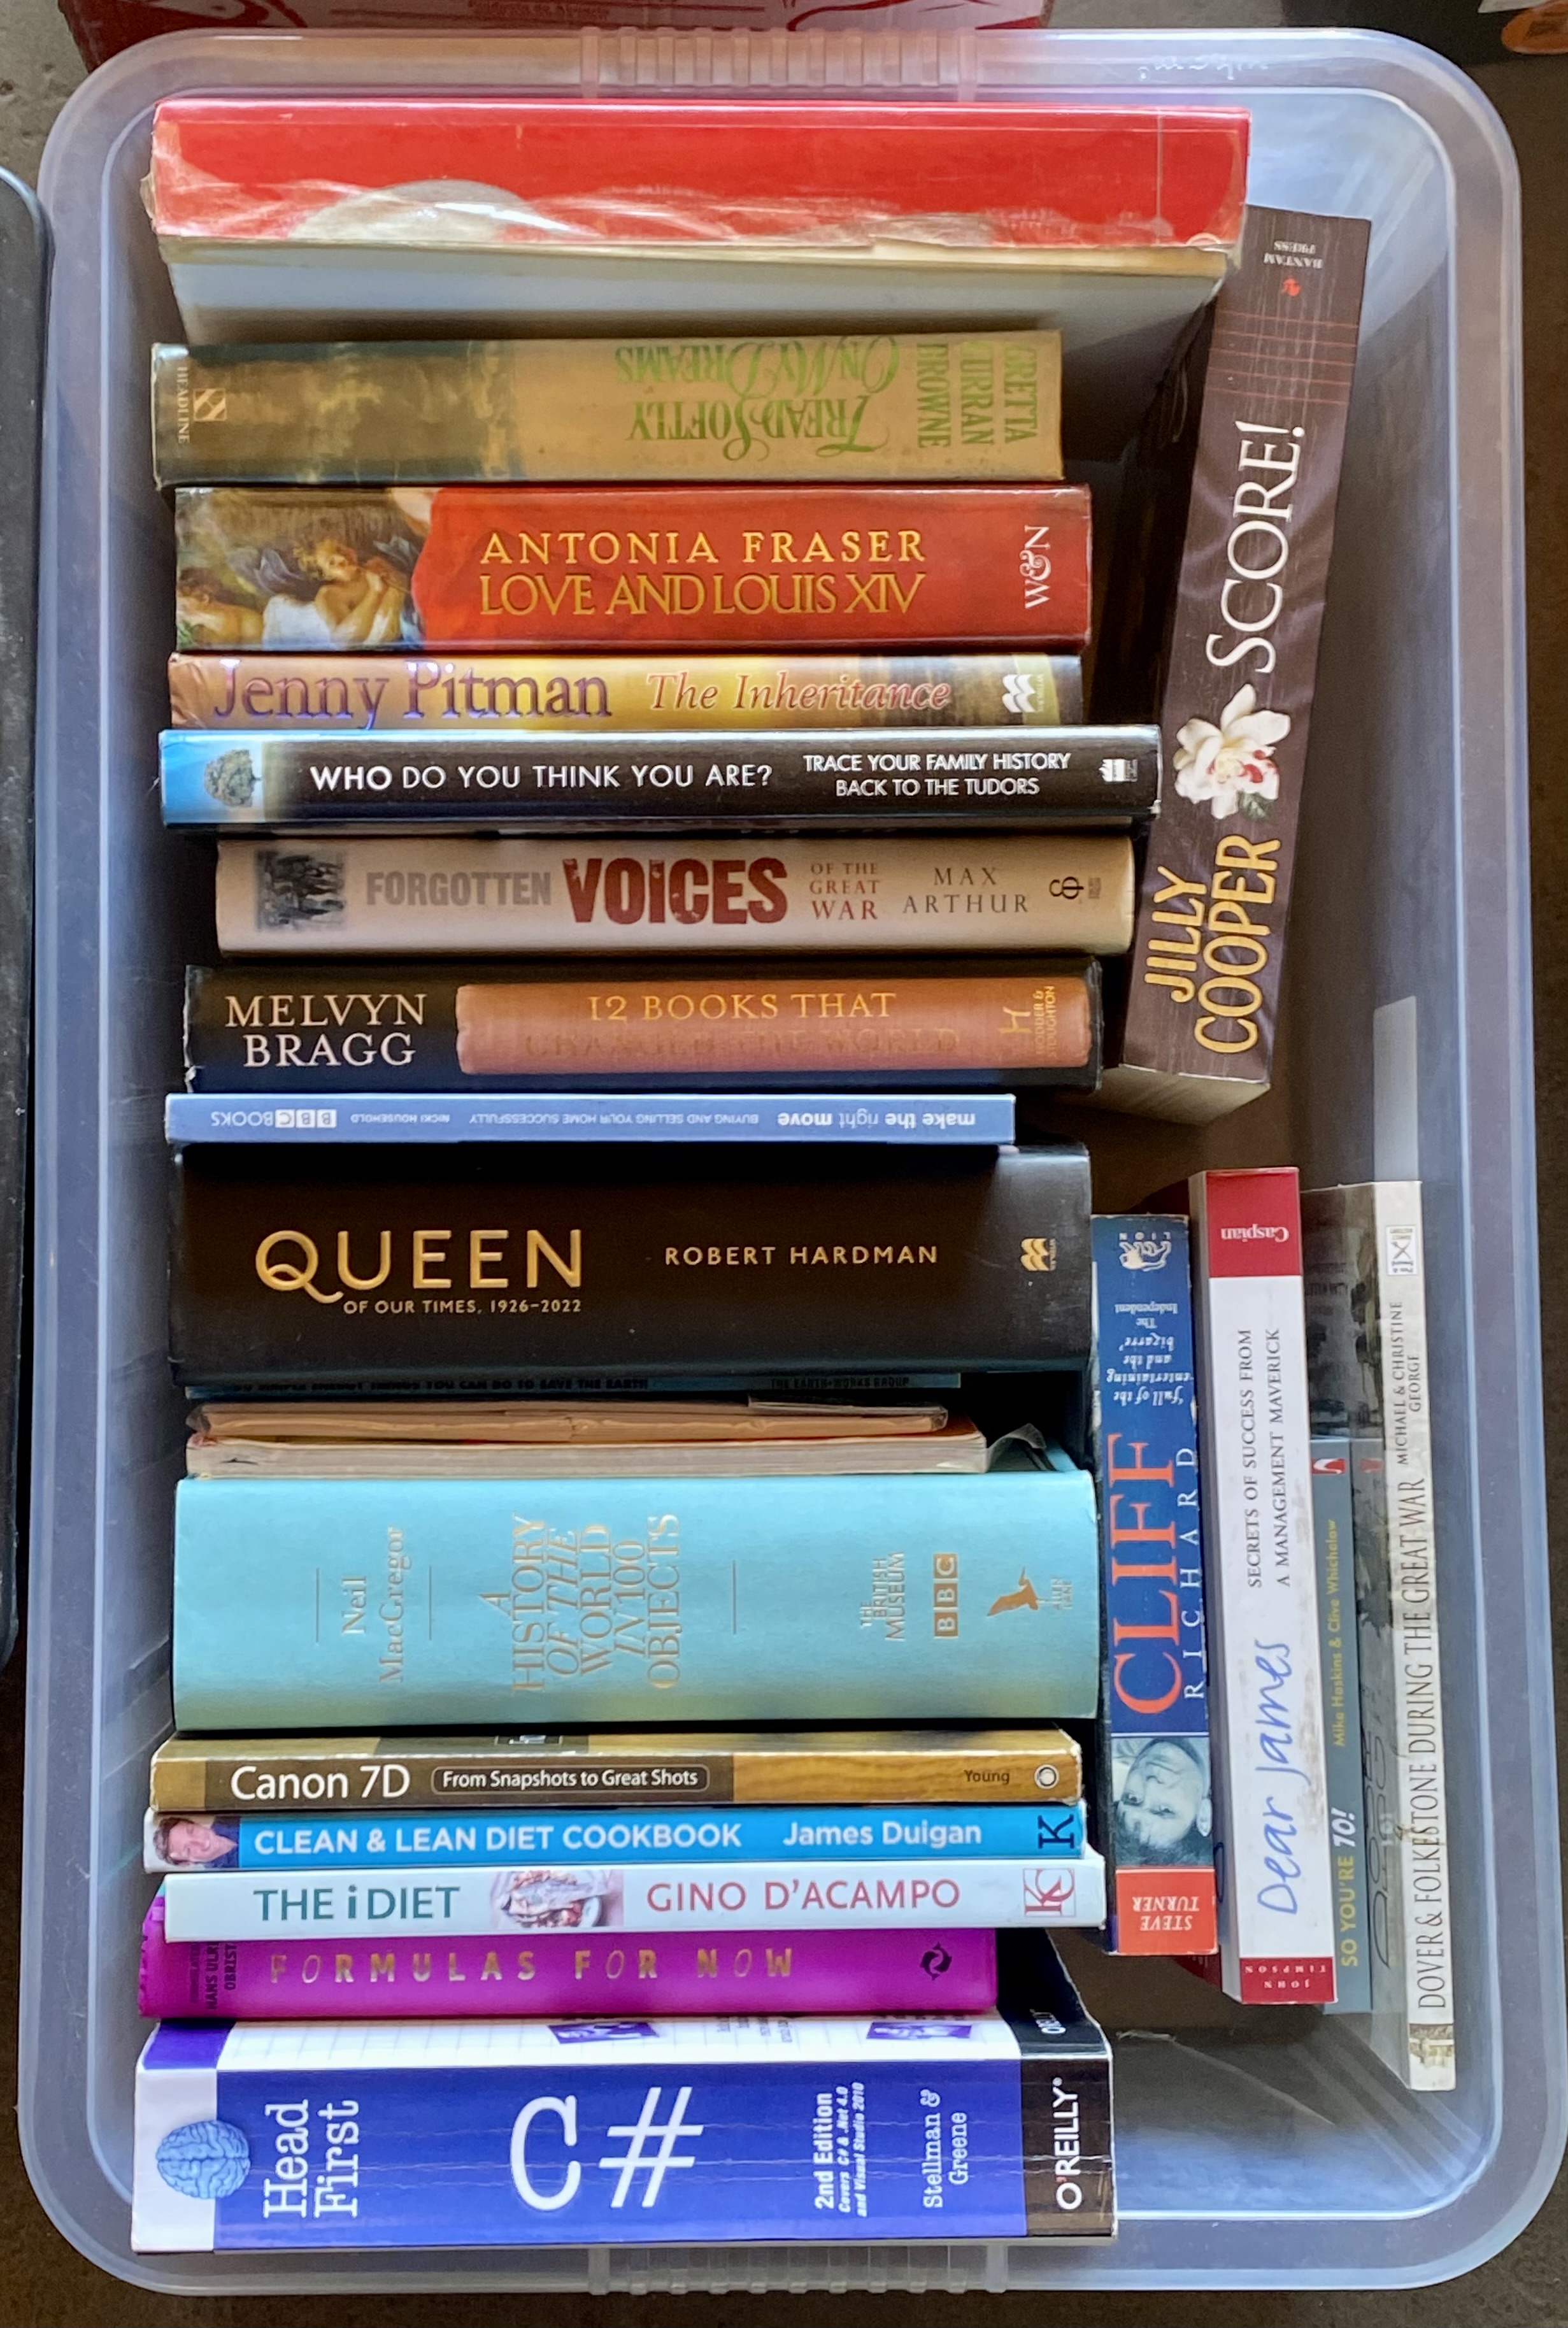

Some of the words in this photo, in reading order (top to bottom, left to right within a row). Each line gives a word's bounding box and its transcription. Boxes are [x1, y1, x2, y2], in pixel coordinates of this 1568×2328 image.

[1264, 253, 1323, 268] BANTAM
[1274, 241, 1316, 254] PRESS
[615, 340, 777, 397] DREAMS
[176, 366, 190, 446] HEADLINE
[916, 343, 951, 448] BROWNE
[624, 396, 770, 462] SOFTLY
[480, 531, 719, 564] ANTONIA
[743, 529, 925, 563] FRASER
[1205, 420, 1305, 673] SCORE!
[480, 573, 595, 617] LOVE
[606, 574, 703, 615] AND
[713, 573, 836, 615] LOUIS
[844, 573, 925, 614] XIV
[214, 659, 388, 730] Jenny
[404, 659, 612, 718] Pitman
[646, 671, 717, 710] The
[734, 670, 951, 711] Inheritance
[310, 766, 392, 790] WHO
[403, 766, 446, 789] DO
[458, 765, 520, 789] YOU
[532, 764, 620, 789] THINK
[632, 764, 693, 788] YOU
[706, 764, 773, 788] ARE?
[804, 755, 866, 773] TRACE
[867, 754, 923, 772] YOUR
[926, 753, 990, 772] FAMILY
[992, 752, 1071, 771] HISTORY
[836, 778, 888, 797] BACK
[891, 778, 920, 797] TO
[923, 778, 959, 796] THE
[964, 777, 1039, 796] TUDORS
[811, 862, 834, 875] OF
[842, 862, 878, 875] THE
[933, 867, 999, 887] MAX
[366, 871, 552, 906] FORGOTTEN
[563, 857, 787, 925] VOICES
[809, 880, 880, 896] GREAT
[903, 894, 1029, 914] ARTHUR
[812, 899, 878, 921] WAR
[1144, 866, 1207, 1003] JILLY
[1194, 834, 1281, 1053] COOPER
[225, 994, 427, 1028] MELVYN
[590, 995, 627, 1021] 12
[641, 994, 778, 1020] BOOKS
[791, 992, 897, 1019] THAT
[243, 1032, 416, 1068] BRAGG
[211, 1111, 274, 1127] BOOKS
[275, 1109, 337, 1128] BBC
[469, 1113, 559, 1124] SUCCESSFULLY
[562, 1114, 597, 1124] HOME
[600, 1114, 632, 1124] YOUR
[636, 1114, 683, 1124] SELLING
[686, 1114, 710, 1124] AND
[713, 1114, 759, 1124] BUYING
[777, 1112, 832, 1126] move
[839, 1108, 879, 1129] right
[884, 1112, 916, 1129] the
[922, 1113, 976, 1129] make
[1119, 1232, 1172, 1241] LION
[1220, 1225, 1289, 1243] Caspian
[255, 1229, 582, 1304] QUEEN
[664, 1246, 776, 1266] ROBERT
[790, 1245, 939, 1265] HARDMAN
[343, 1300, 369, 1314] OF
[374, 1299, 415, 1314] OUR
[422, 1299, 482, 1315] TIMES,
[1136, 1317, 1157, 1329] The
[1238, 1329, 1253, 1382] FROM
[1390, 1302, 1406, 1381] CHRISTINE
[1146, 1355, 1172, 1369] and
[1265, 1328, 1283, 1424] MAVERICK
[1113, 1391, 1133, 1406] the
[1134, 1386, 1150, 1405] of
[1240, 1389, 1257, 1469] SUCCESS
[1393, 1402, 1409, 1465] MICHAEL
[1243, 1476, 1258, 1501] OF
[1271, 1428, 1290, 1562] MANAGEMENT
[1398, 1478, 1425, 1527] WAR
[1245, 1508, 1262, 1589] SECRETS
[1325, 1518, 1339, 1594] Whichelow
[1107, 1432, 1183, 1714] CLIFF
[1176, 1448, 1205, 1699] RICHARD
[1276, 1575, 1291, 1587] A
[1399, 1536, 1431, 1610] GREAT
[341, 1576, 367, 1636] Neil
[379, 1525, 411, 1684] MacGregor
[511, 1513, 546, 1692] HISTORY
[579, 1523, 614, 1676] WORLD
[646, 1513, 683, 1690] OBJECTS
[885, 1550, 906, 1642] MUSEUM
[933, 1553, 959, 1639] BBC
[1404, 1611, 1433, 1656] THE
[1255, 1638, 1312, 1786] James
[1404, 1663, 1437, 1753] DURING
[231, 1764, 348, 1801] Canon
[359, 1764, 410, 1798] 7D
[443, 1771, 487, 1789] From
[490, 1768, 577, 1790] Snapshots
[580, 1770, 599, 1787] to
[602, 1769, 648, 1786] Great
[651, 1768, 698, 1785] Shots
[964, 1768, 1011, 1787] Young
[255, 1829, 358, 1855] CLEAN
[366, 1829, 386, 1853] &
[396, 1827, 477, 1853] LEAN
[486, 1825, 554, 1852] DIET
[562, 1823, 742, 1850] COOKBOOK
[783, 1821, 873, 1846] James
[881, 1820, 982, 1850] Duigan
[1330, 1806, 1357, 1848] 70!
[1408, 1763, 1443, 1903] FOLKESTONE
[1257, 1796, 1303, 1915] Dear
[253, 1887, 334, 1922] THE
[646, 1882, 746, 1911] GINO
[765, 1878, 961, 1910] D'ACAMPO
[1132, 1896, 1199, 1911] TURNER
[1337, 1854, 1357, 1932] YOU'RE
[1139, 1915, 1193, 1931] STEVE
[1422, 1912, 1443, 1927] &
[224, 1943, 238, 1991] OBRIST
[269, 1950, 536, 1983] FORMULAS
[574, 1948, 657, 1980] FOR
[695, 1947, 794, 1978] NOW
[1244, 1964, 1327, 1974] TIMPSON
[1341, 1939, 1358, 1967] SO
[1416, 1932, 1446, 2010] DOVER
[205, 1975, 218, 2010] HANS
[1264, 1979, 1311, 1989] JOHN
[852, 2082, 865, 2111] 2010
[920, 2089, 941, 2108] &
[813, 2093, 834, 2164] Edition
[852, 2113, 866, 2152] Studio
[262, 2098, 309, 2219] Head
[313, 2099, 360, 2218] First
[510, 2086, 704, 2212] C#
[922, 2113, 943, 2208] Stellman
[948, 2111, 969, 2185] Greene
[853, 2152, 866, 2190] Visual
[813, 2171, 834, 2210] 2nd
[838, 2171, 851, 2213] Covers
[853, 2193, 867, 2217] and
